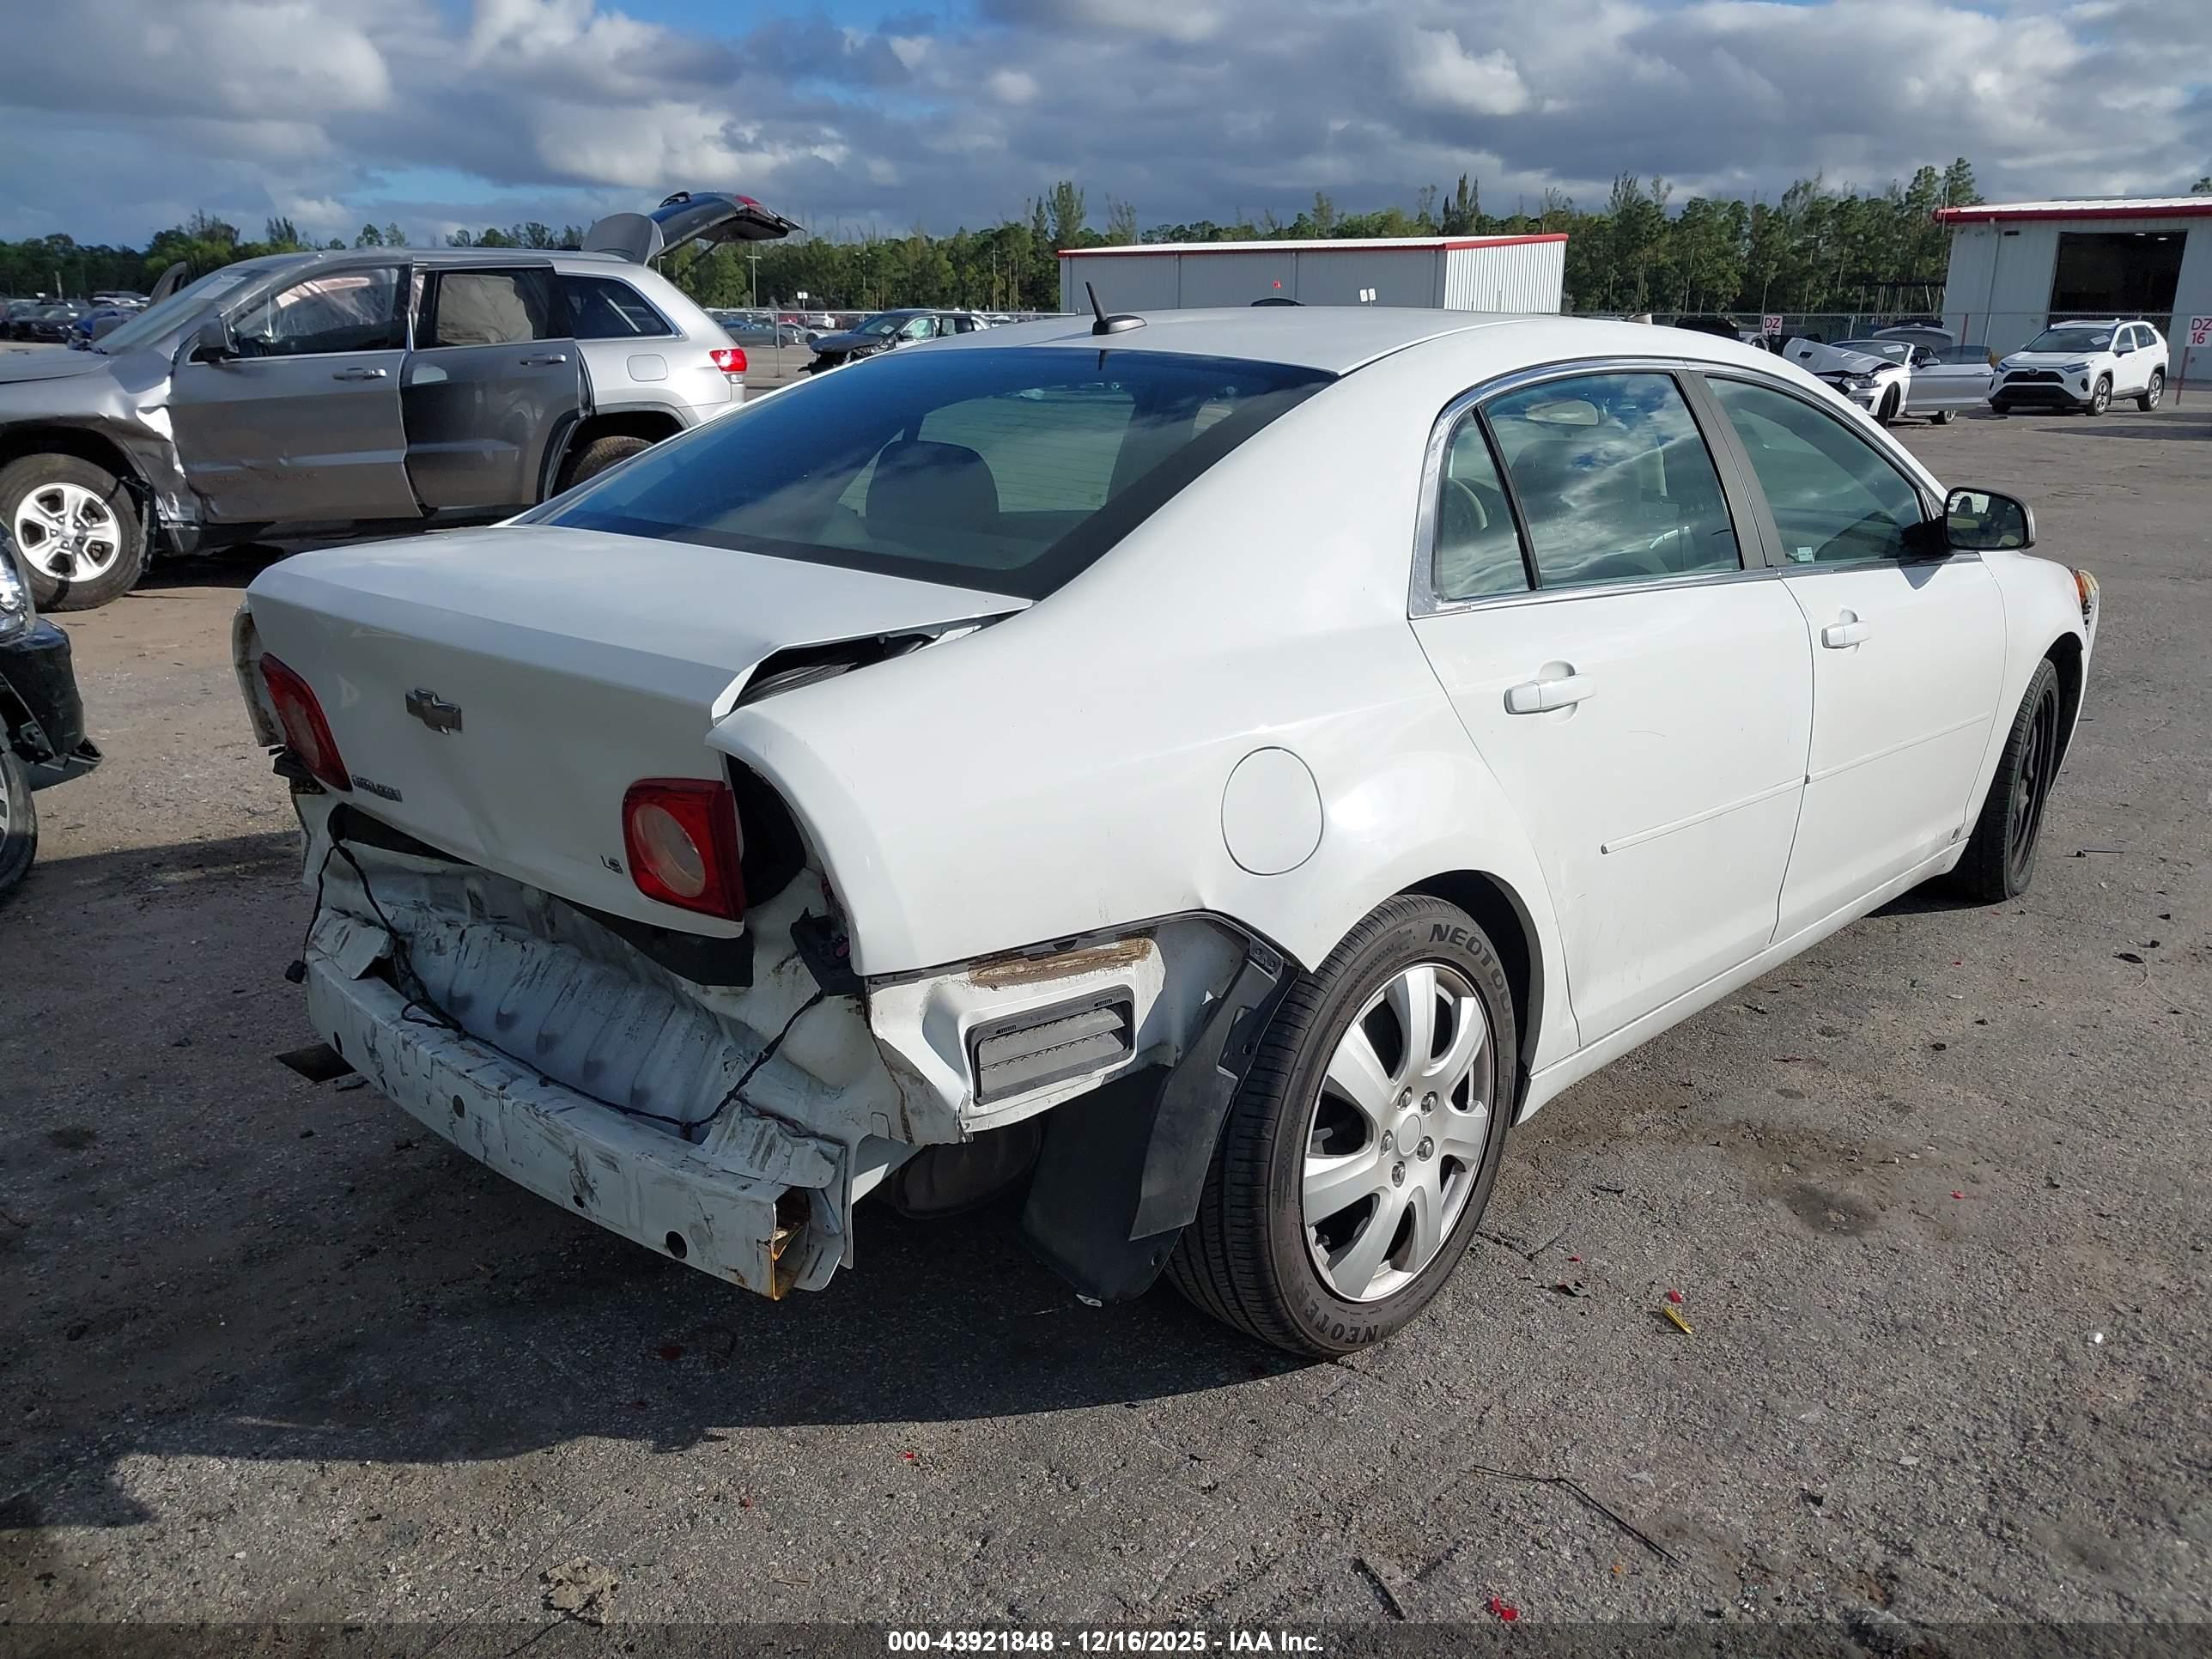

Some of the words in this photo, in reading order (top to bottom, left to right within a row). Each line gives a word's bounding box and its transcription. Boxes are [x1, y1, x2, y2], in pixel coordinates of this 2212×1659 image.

[1765, 318, 1780, 328] DZ
[2191, 319, 2212, 331] DZ
[2192, 332, 2205, 344] 16
